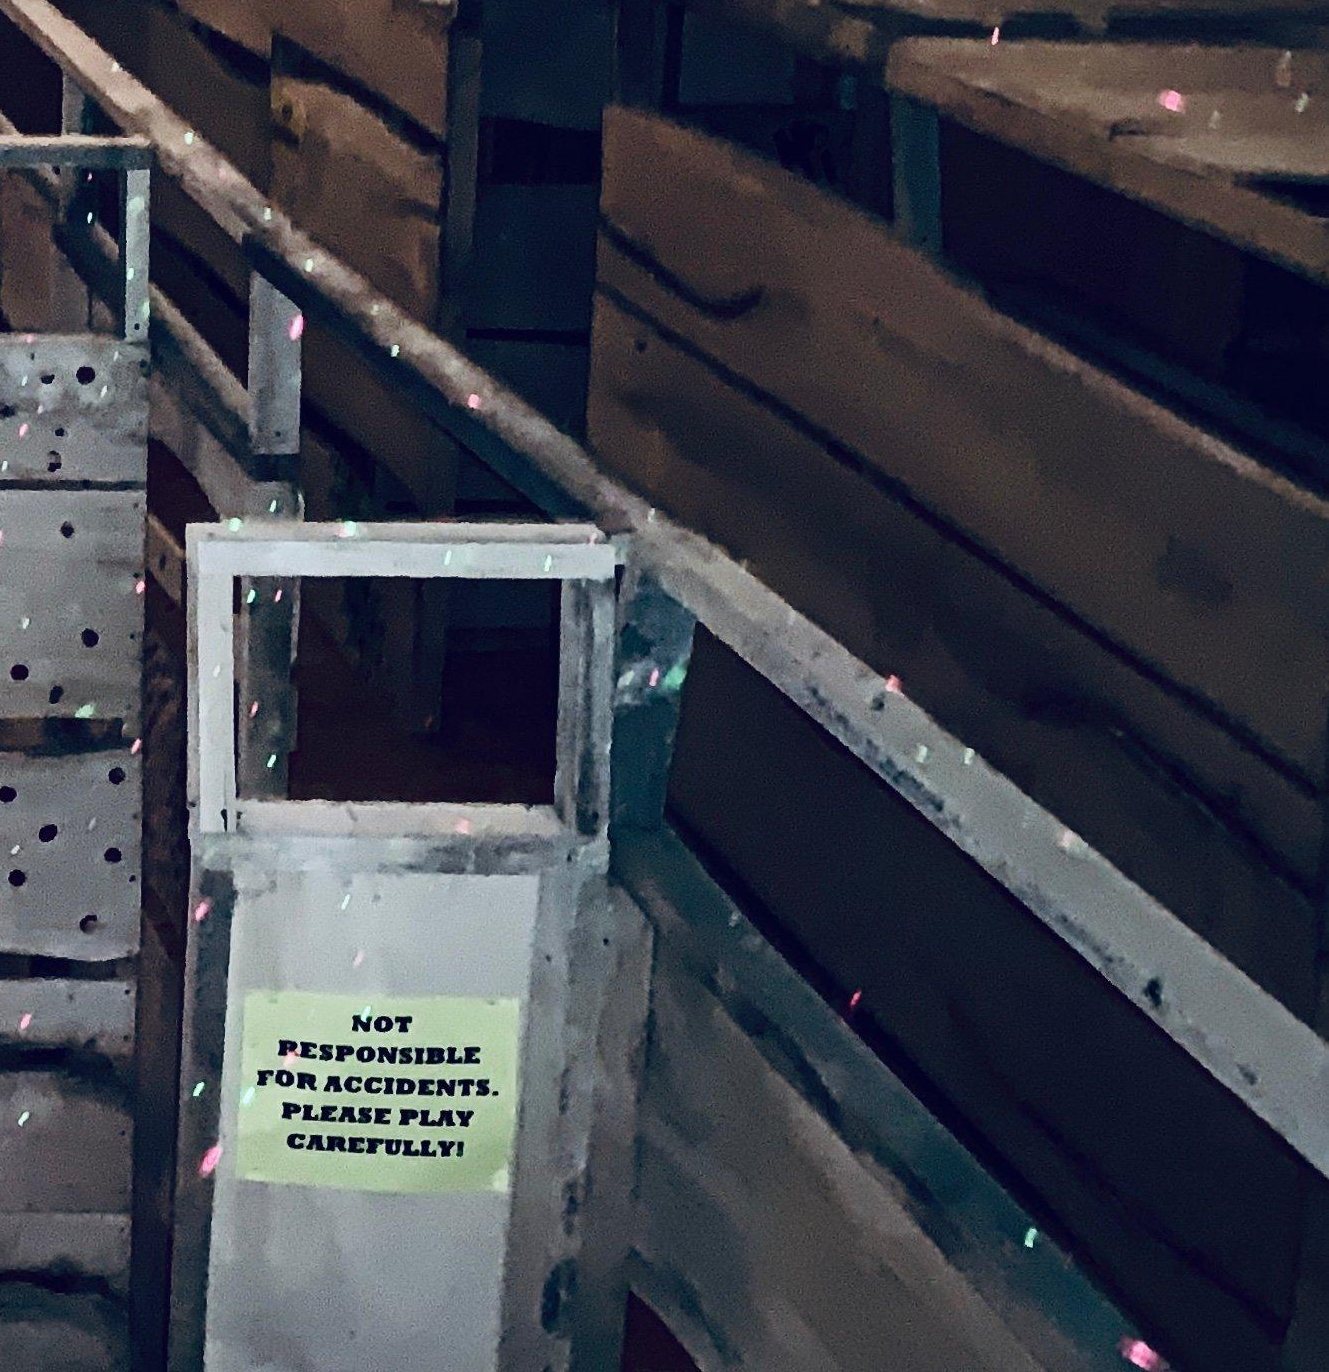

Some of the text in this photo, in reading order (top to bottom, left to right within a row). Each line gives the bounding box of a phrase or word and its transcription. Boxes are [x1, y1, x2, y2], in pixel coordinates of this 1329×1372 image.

[351, 1014, 413, 1033] NOT
[277, 1039, 482, 1065] RESPONSIBLE
[256, 1069, 499, 1097] FOR ACCIDENTS.
[281, 1101, 475, 1128] PLEASE PLAY
[286, 1133, 465, 1158] CAREFULLY!
